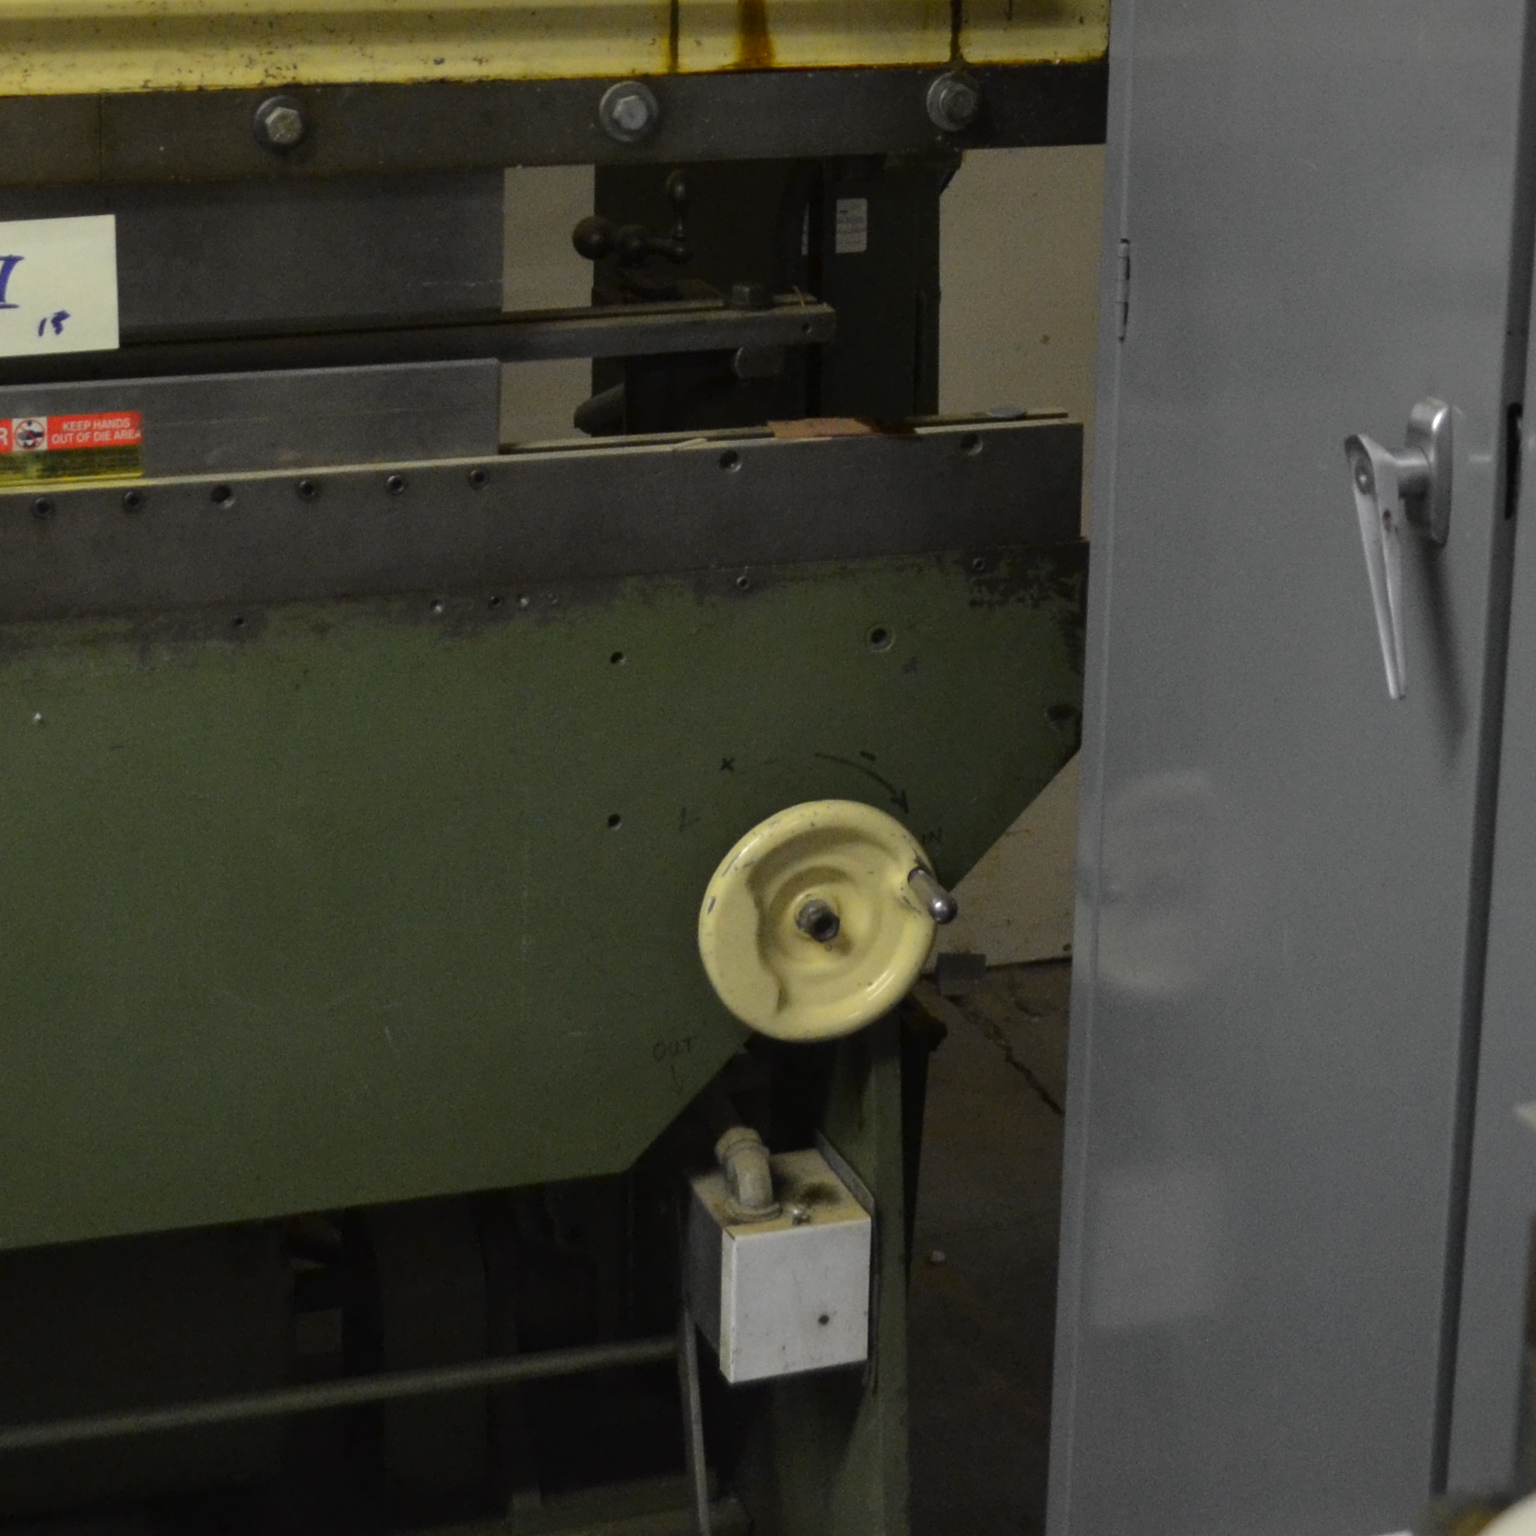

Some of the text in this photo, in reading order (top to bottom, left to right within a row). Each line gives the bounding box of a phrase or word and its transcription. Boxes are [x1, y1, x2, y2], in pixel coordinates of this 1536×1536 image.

[61, 417, 131, 432] KEEP HANDS
[51, 428, 142, 445] OUT OF DIE AREA
